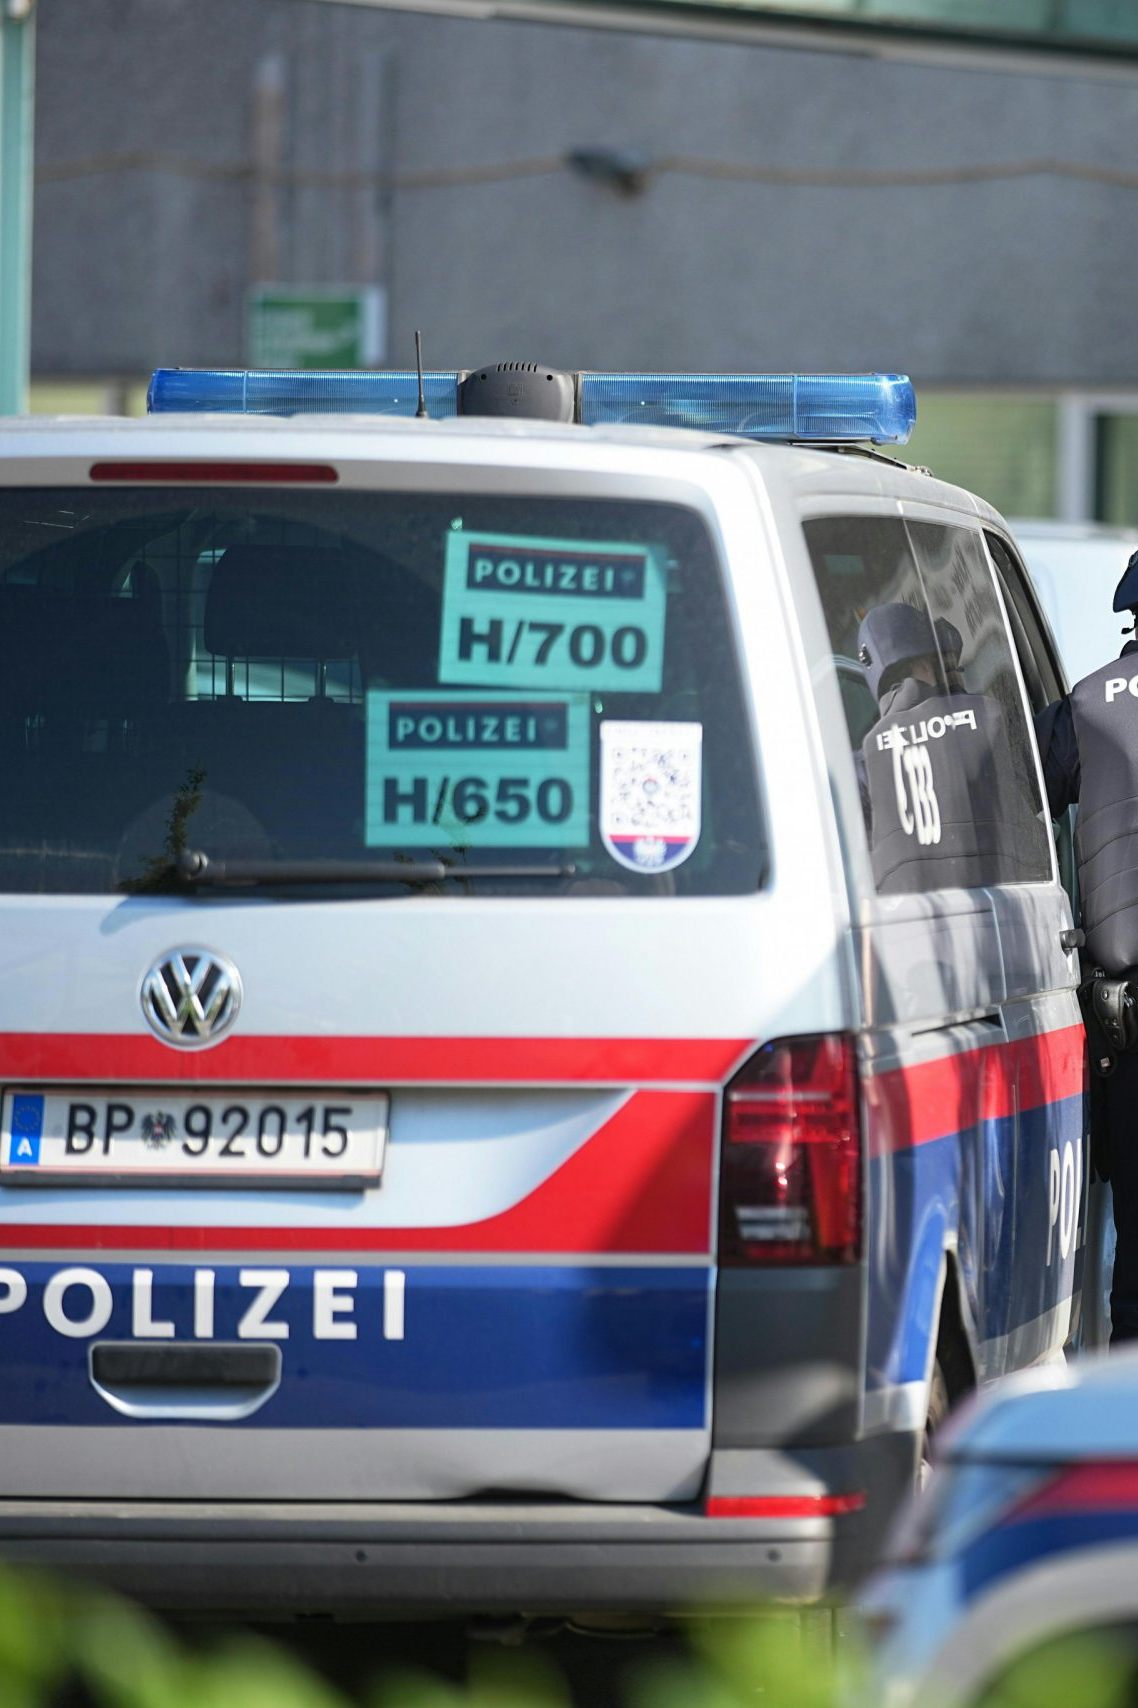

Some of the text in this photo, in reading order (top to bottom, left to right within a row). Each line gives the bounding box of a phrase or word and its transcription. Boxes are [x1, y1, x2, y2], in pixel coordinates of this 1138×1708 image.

[475, 558, 614, 592] POLIZEI
[457, 616, 648, 670] H/700
[396, 716, 537, 743] POLIZEI
[381, 776, 574, 826] H/650
[16, 1137, 33, 1157] A
[64, 1102, 354, 1158] BP 92015
